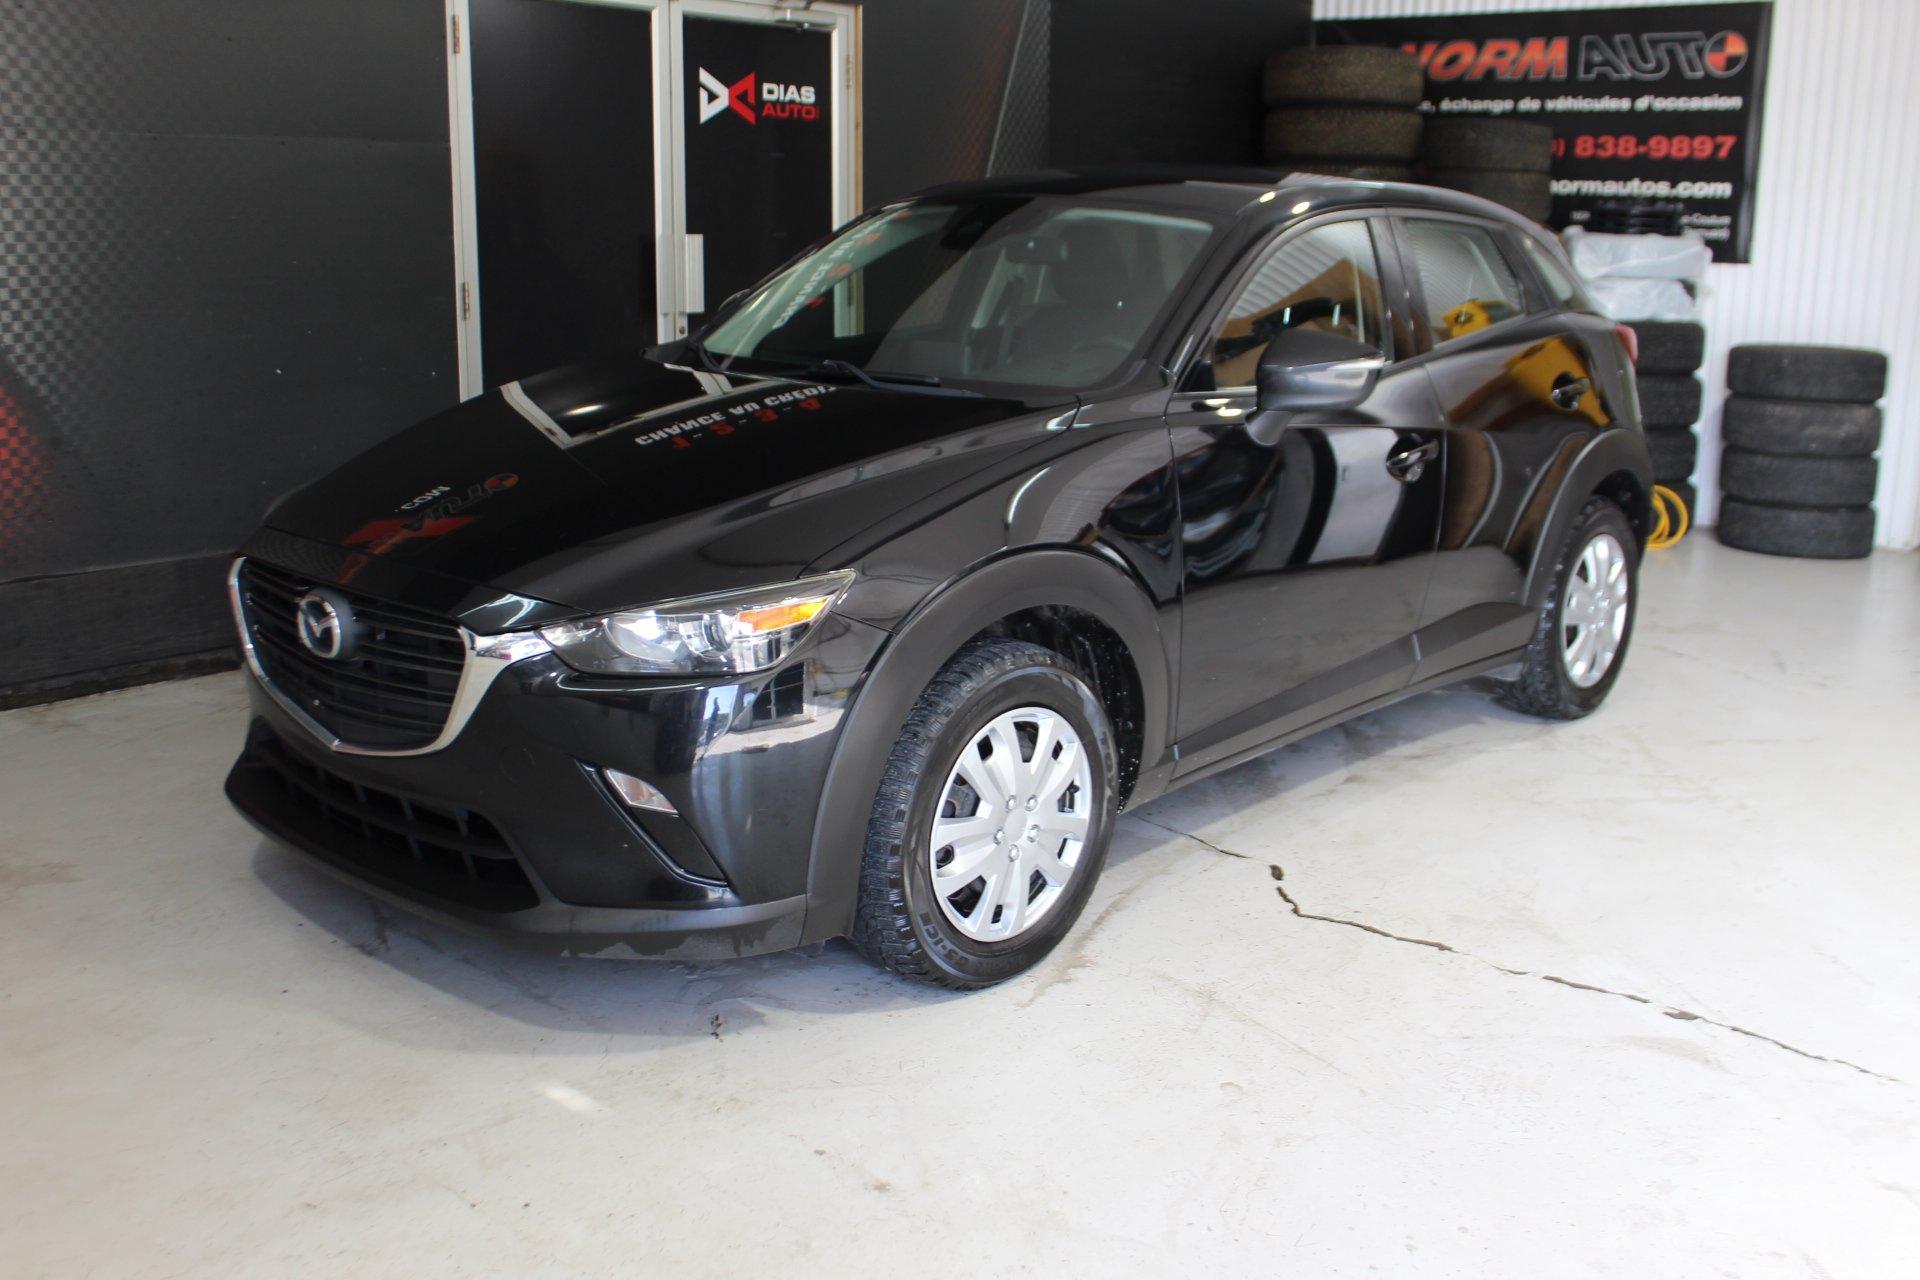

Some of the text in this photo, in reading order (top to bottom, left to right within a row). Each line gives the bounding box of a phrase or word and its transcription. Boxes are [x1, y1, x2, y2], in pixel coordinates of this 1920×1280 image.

[1577, 30, 1748, 82] AUTO
[762, 82, 816, 103] DIAS
[762, 103, 816, 119] AUTO
[1439, 97, 1514, 115] échange
[1516, 96, 1541, 111] de
[1545, 93, 1632, 112] véhicules
[1634, 93, 1742, 112] d'occasion
[1574, 134, 1737, 159] 838-9897
